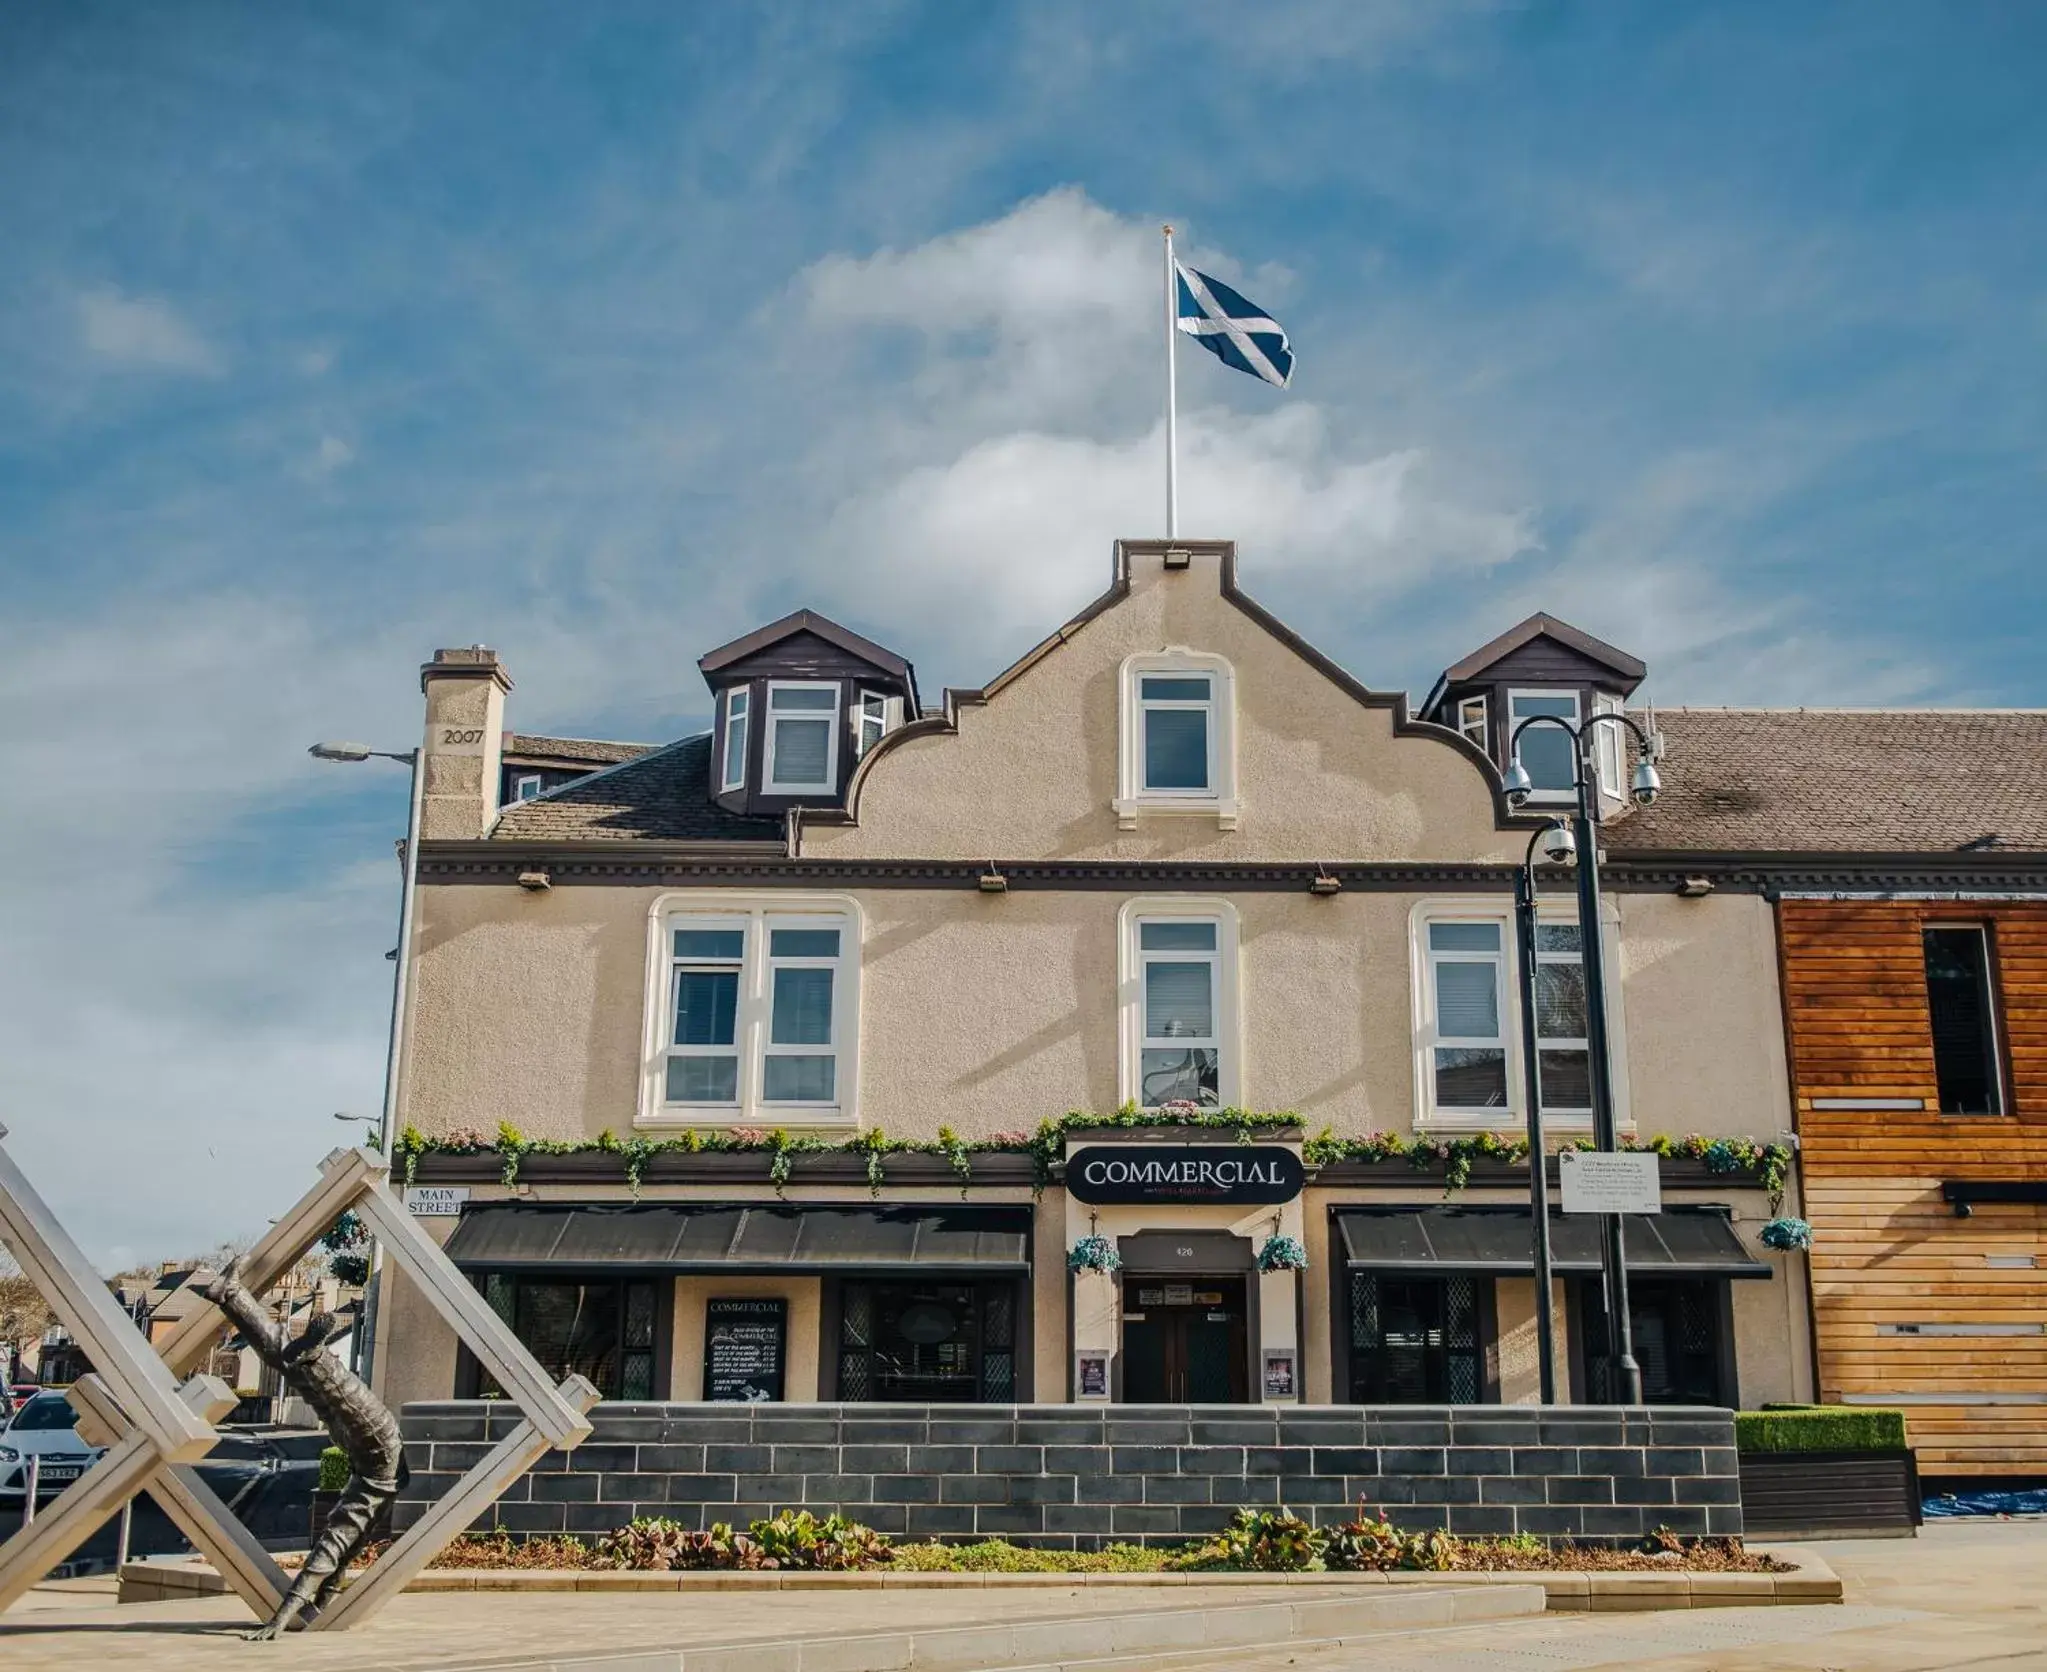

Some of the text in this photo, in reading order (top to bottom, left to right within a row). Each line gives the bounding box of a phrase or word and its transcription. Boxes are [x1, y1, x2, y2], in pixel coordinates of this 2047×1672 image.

[444, 729, 484, 745] 2007
[1084, 1160, 1285, 1189] COMMERCIAL
[418, 1189, 455, 1201] MAIN
[408, 1201, 461, 1213] STREET
[710, 1302, 780, 1313] COMMERCIAL
